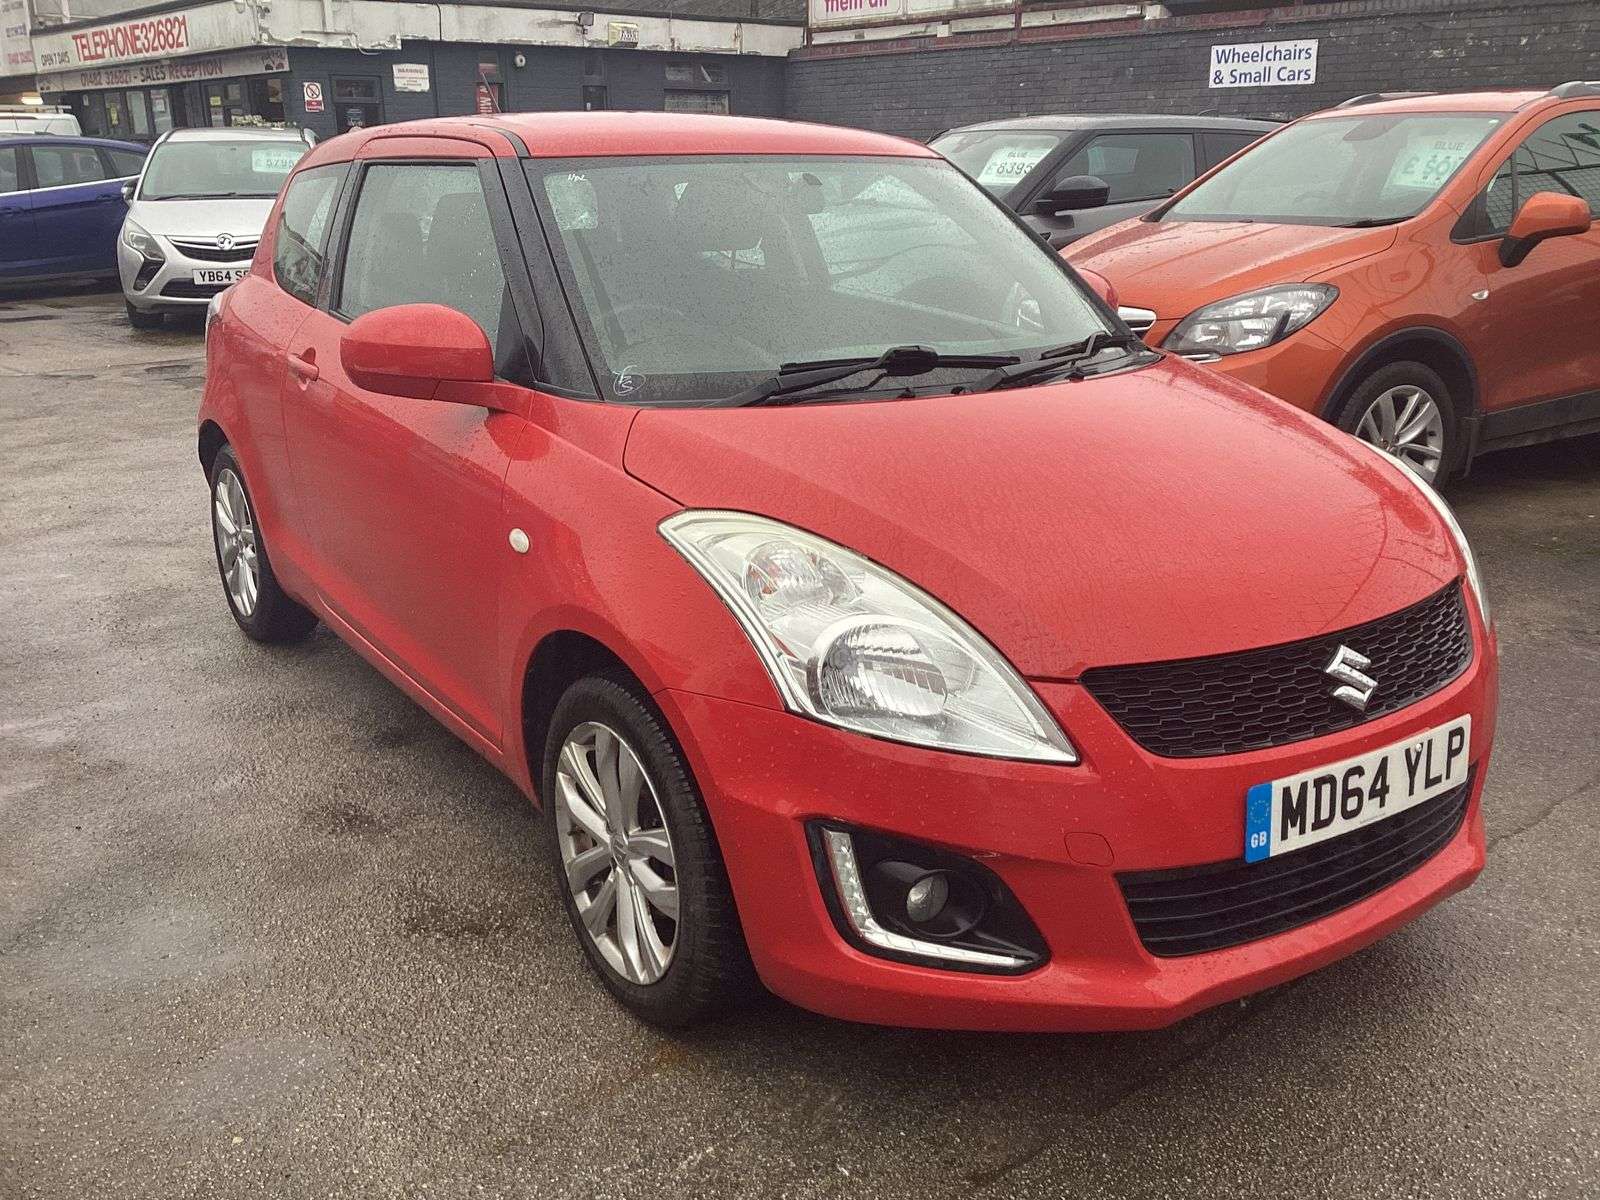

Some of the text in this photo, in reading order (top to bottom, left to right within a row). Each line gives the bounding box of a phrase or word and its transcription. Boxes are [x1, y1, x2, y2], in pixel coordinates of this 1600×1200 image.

[1216, 44, 1312, 64] Wheelchairs
[140, 64, 166, 82] SALES
[168, 58, 224, 80] RECEPTION
[1213, 66, 1311, 85] & Small Cars
[199, 270, 231, 282] YB64
[1280, 726, 1465, 842] MD64 YLP
[1250, 830, 1267, 849] GB
